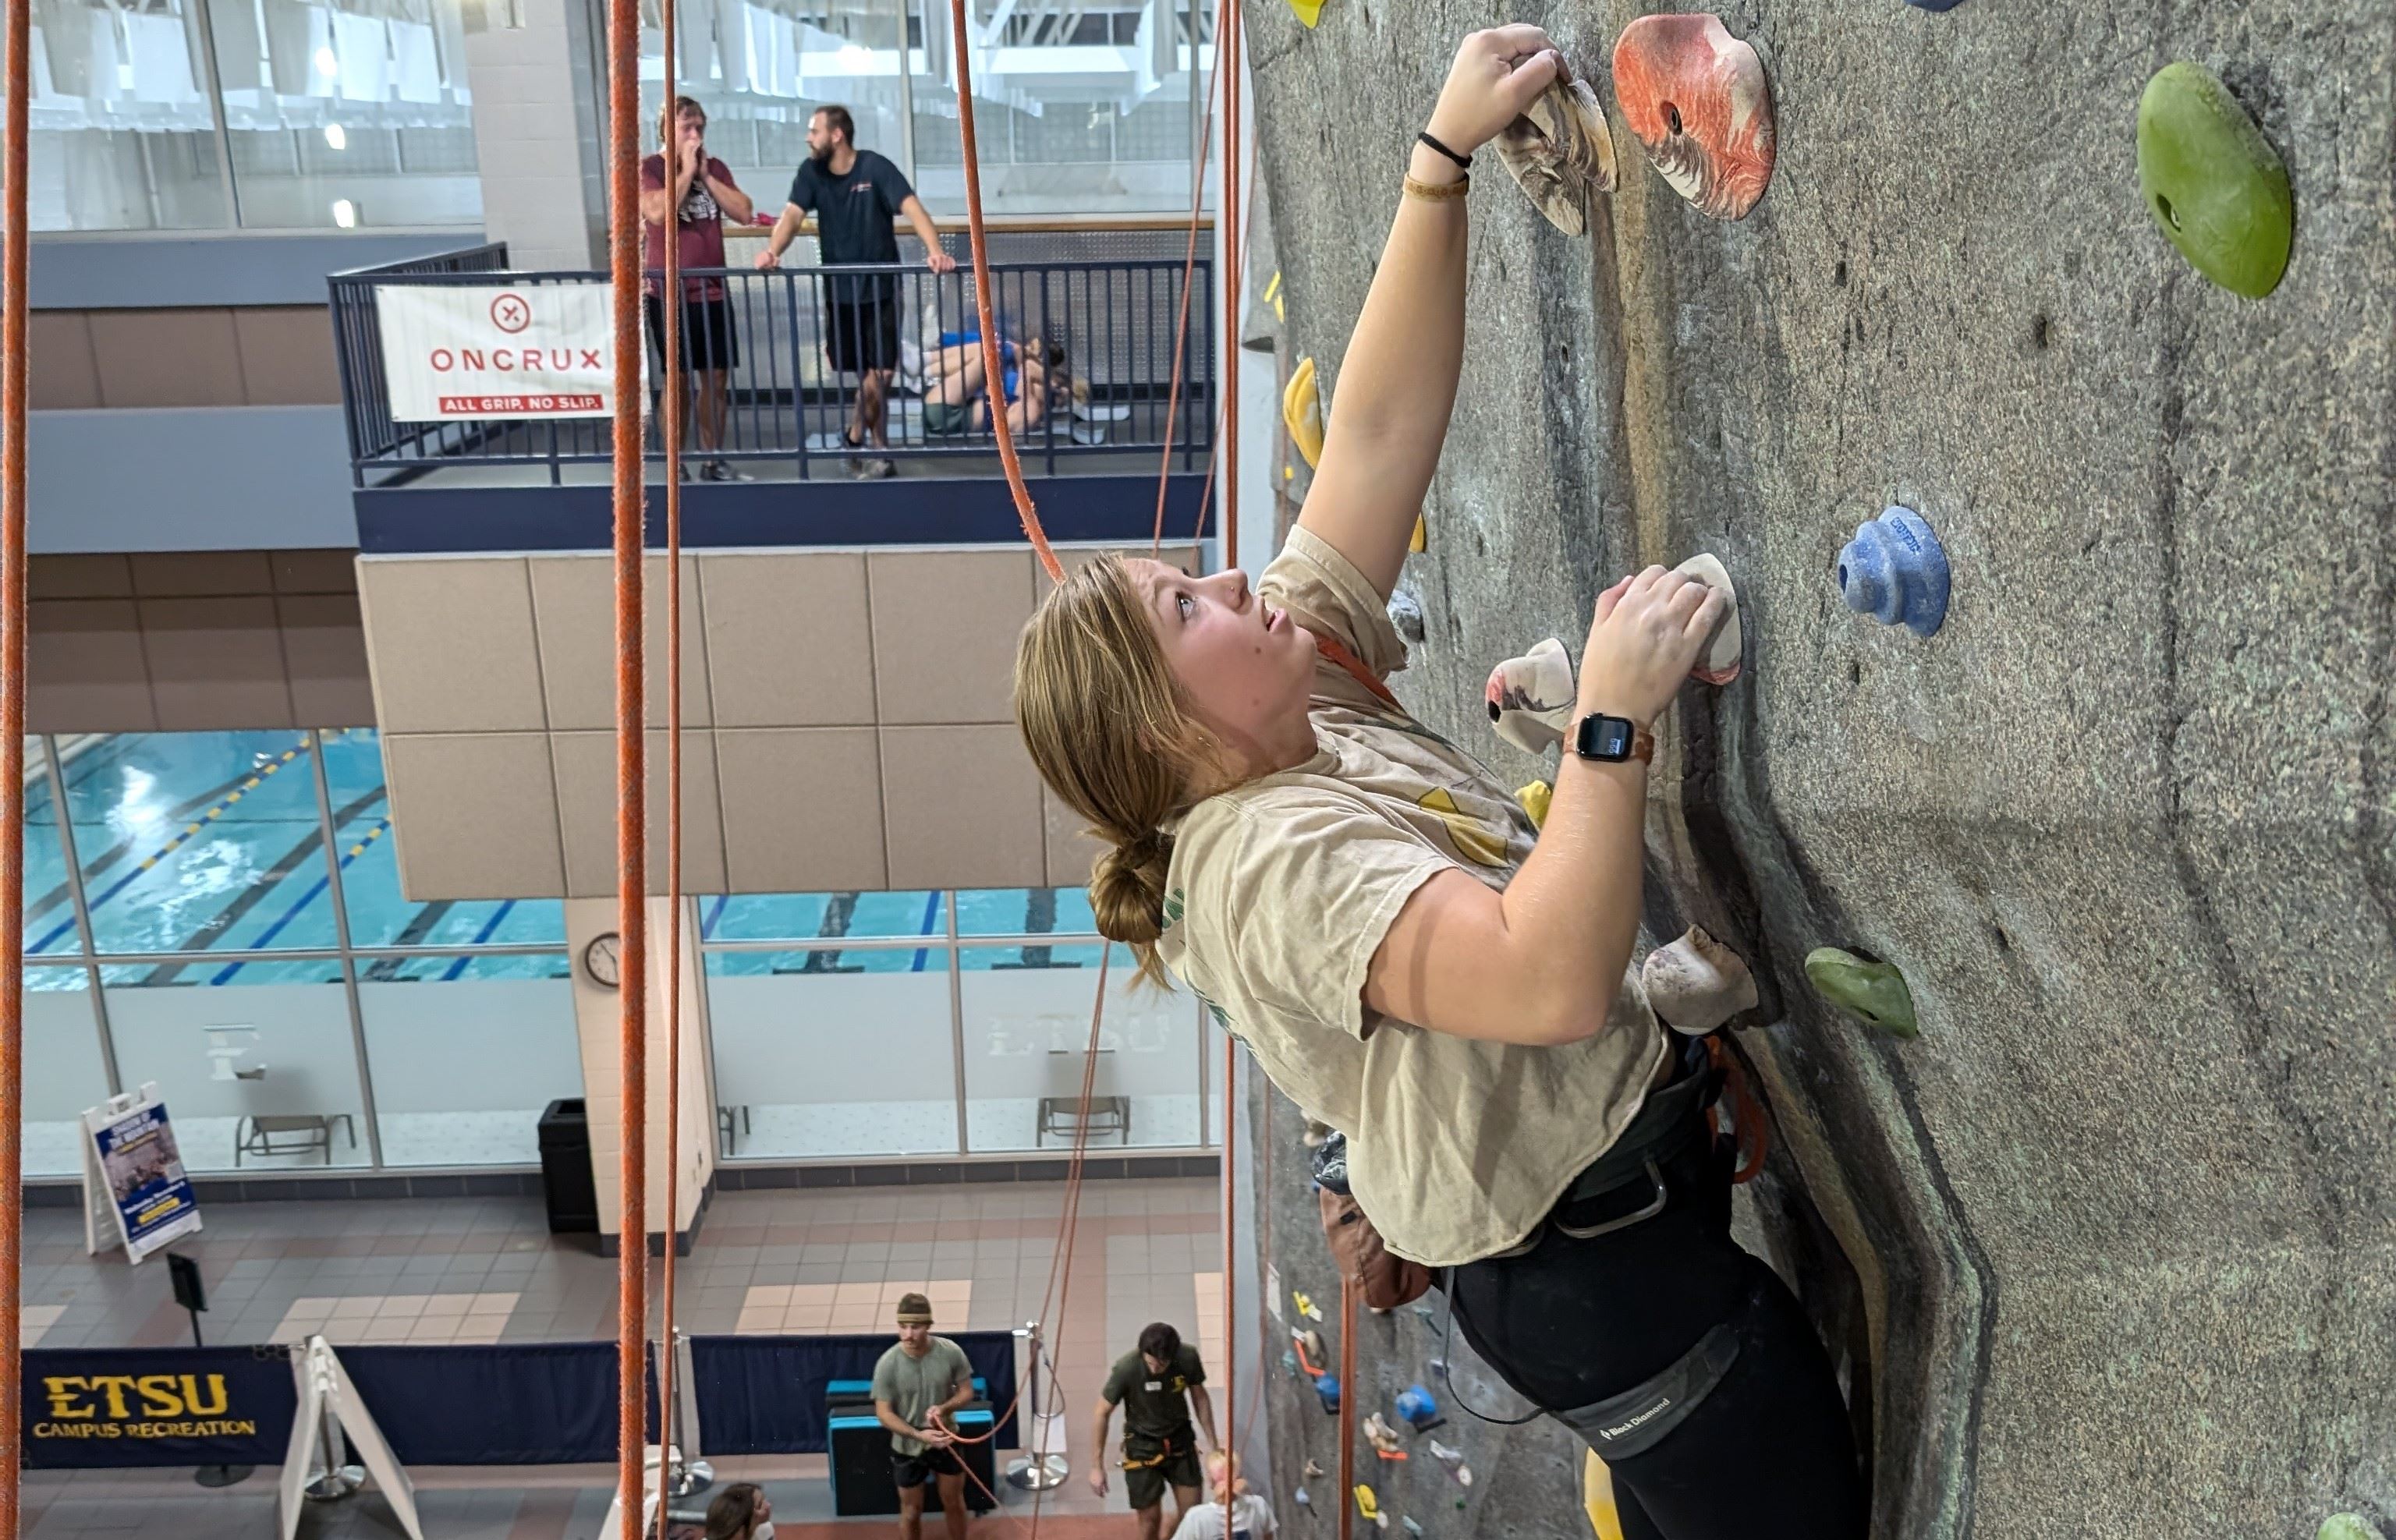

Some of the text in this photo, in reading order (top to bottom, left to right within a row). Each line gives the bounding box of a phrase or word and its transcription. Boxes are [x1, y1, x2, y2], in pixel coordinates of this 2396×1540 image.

[431, 349, 602, 372] ONCRUX
[445, 397, 599, 411] ALL GRIP. NO SLIP.
[43, 1374, 229, 1419] ETSU
[1608, 1398, 1671, 1436] Black Diamond
[33, 1420, 256, 1439] CAMPUS RECREATION
